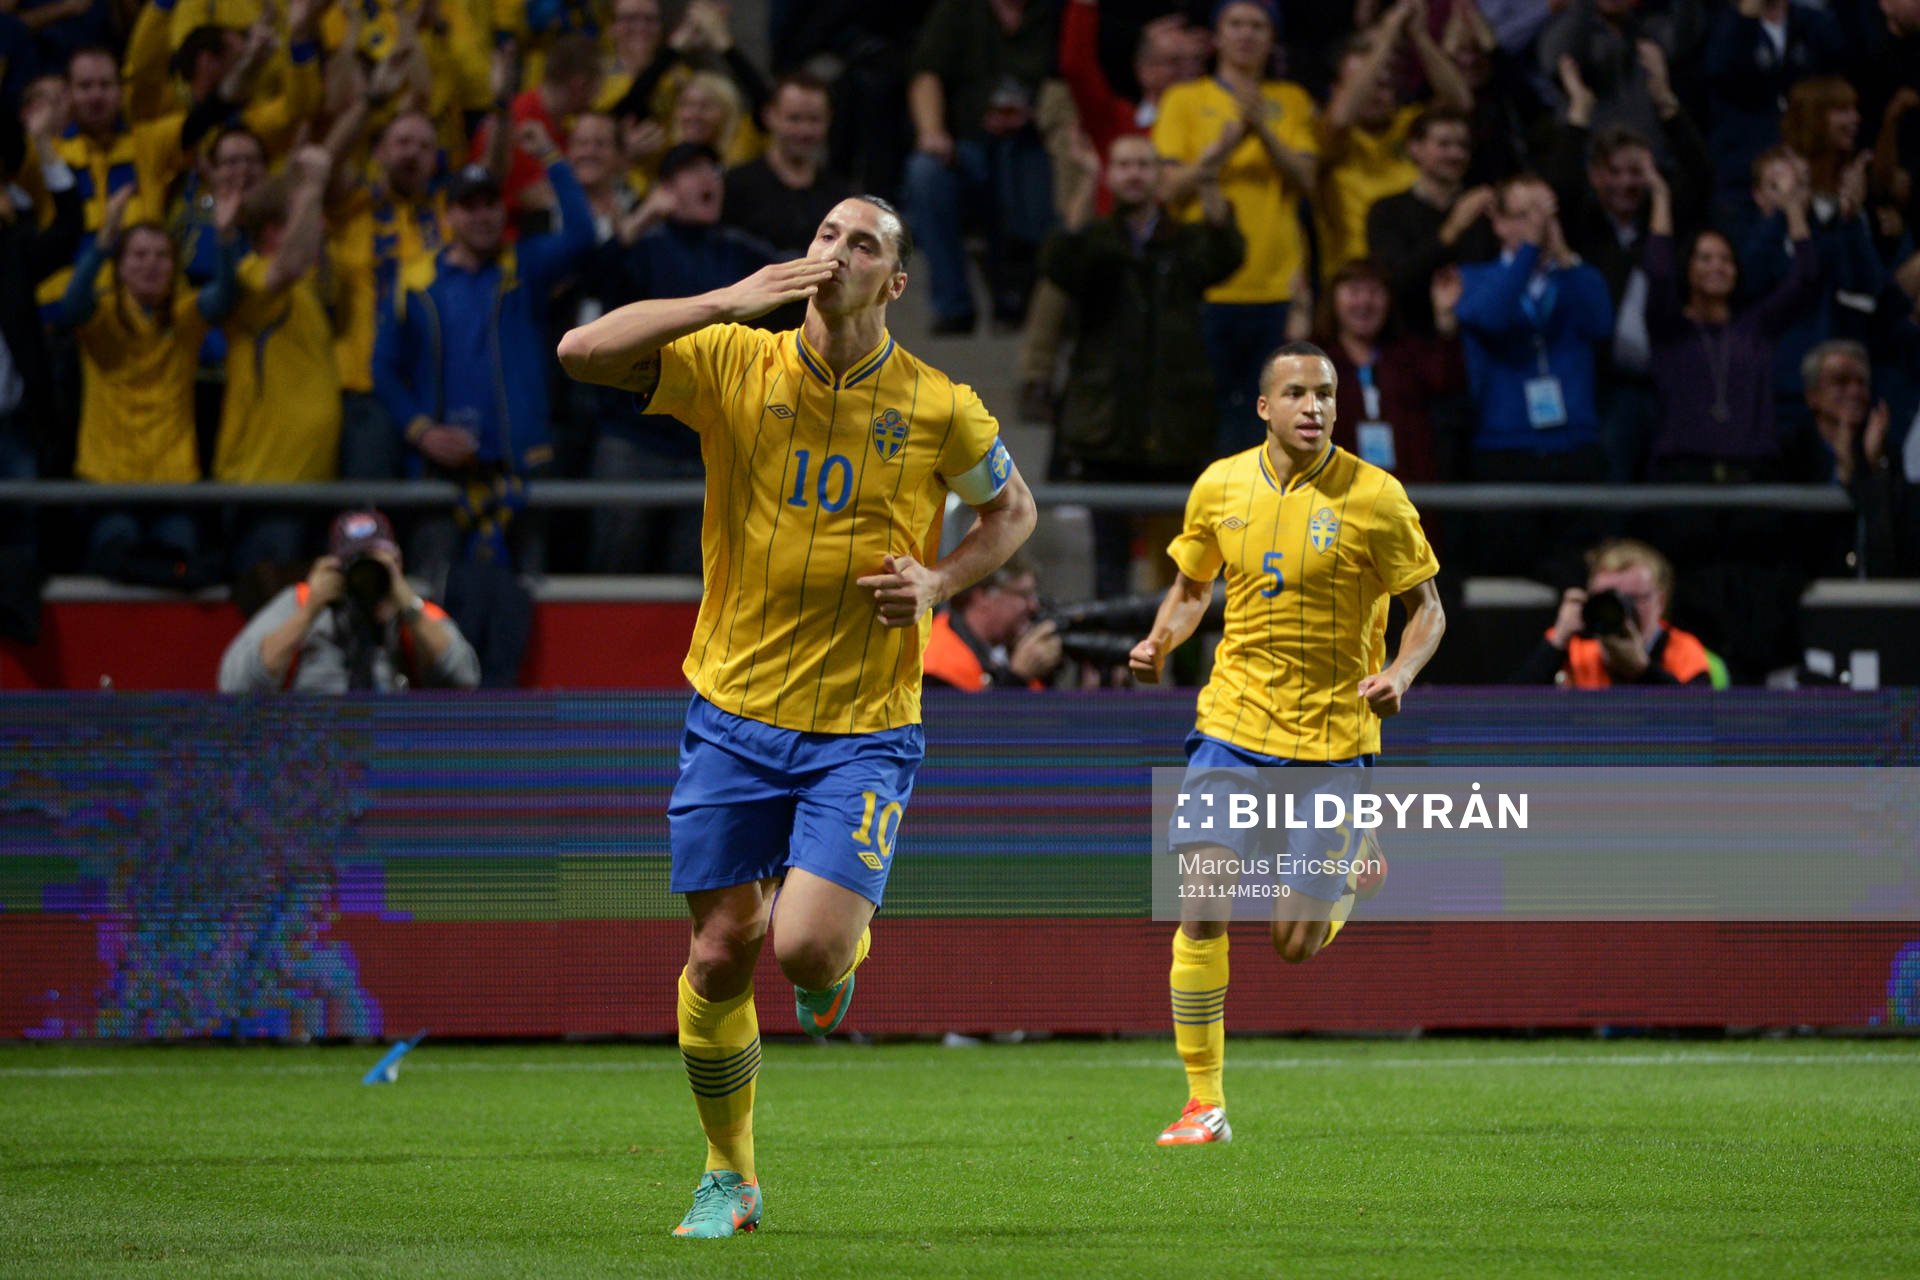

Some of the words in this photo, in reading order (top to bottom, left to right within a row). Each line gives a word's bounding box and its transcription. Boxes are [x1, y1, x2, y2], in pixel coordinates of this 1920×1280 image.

[787, 449, 853, 513] 10
[1261, 551, 1284, 598] 5
[852, 790, 903, 857] 10
